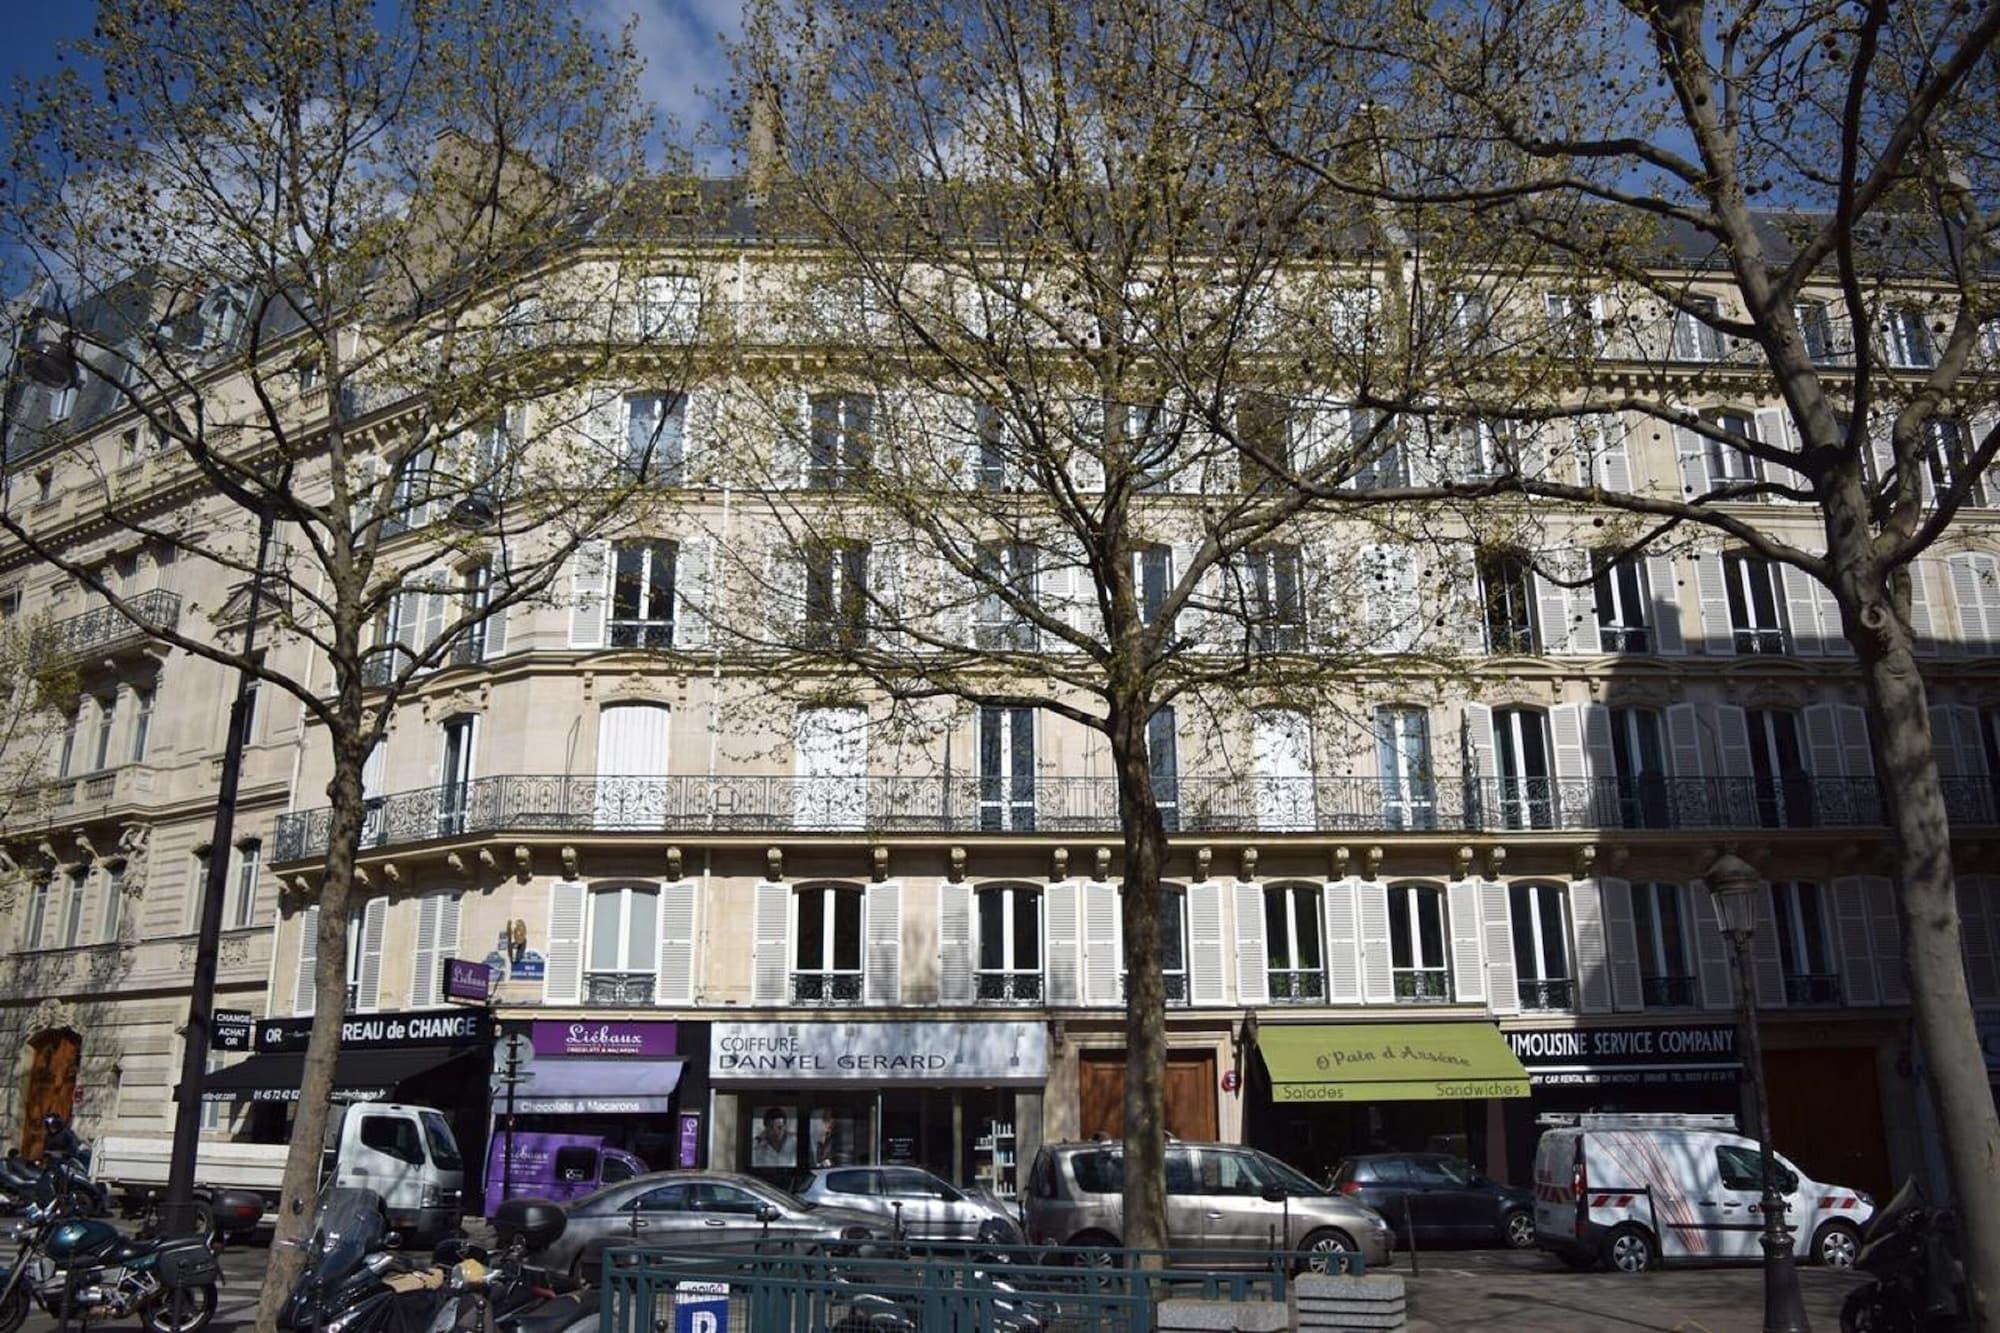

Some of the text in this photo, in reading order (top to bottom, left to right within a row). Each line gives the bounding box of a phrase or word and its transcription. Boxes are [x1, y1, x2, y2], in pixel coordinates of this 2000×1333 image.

[216, 1013, 250, 1024] CHANGE
[218, 1027, 246, 1037] ACHAT
[265, 1028, 282, 1042] OR
[342, 1021, 383, 1041] REAU
[386, 1020, 406, 1039] de
[408, 1017, 478, 1038] CHANGE
[566, 1024, 643, 1043] Liébaux
[225, 1036, 239, 1046] OR
[720, 1037, 799, 1052] COIFFURE
[1594, 1031, 1654, 1055] SERVICE
[1658, 1029, 1734, 1052] COMPANY
[719, 1055, 946, 1069] DANYEL GERARD
[1283, 1083, 1520, 1099] Salades Sandwiches
[520, 1101, 640, 1113] Chocolats & Macarons
